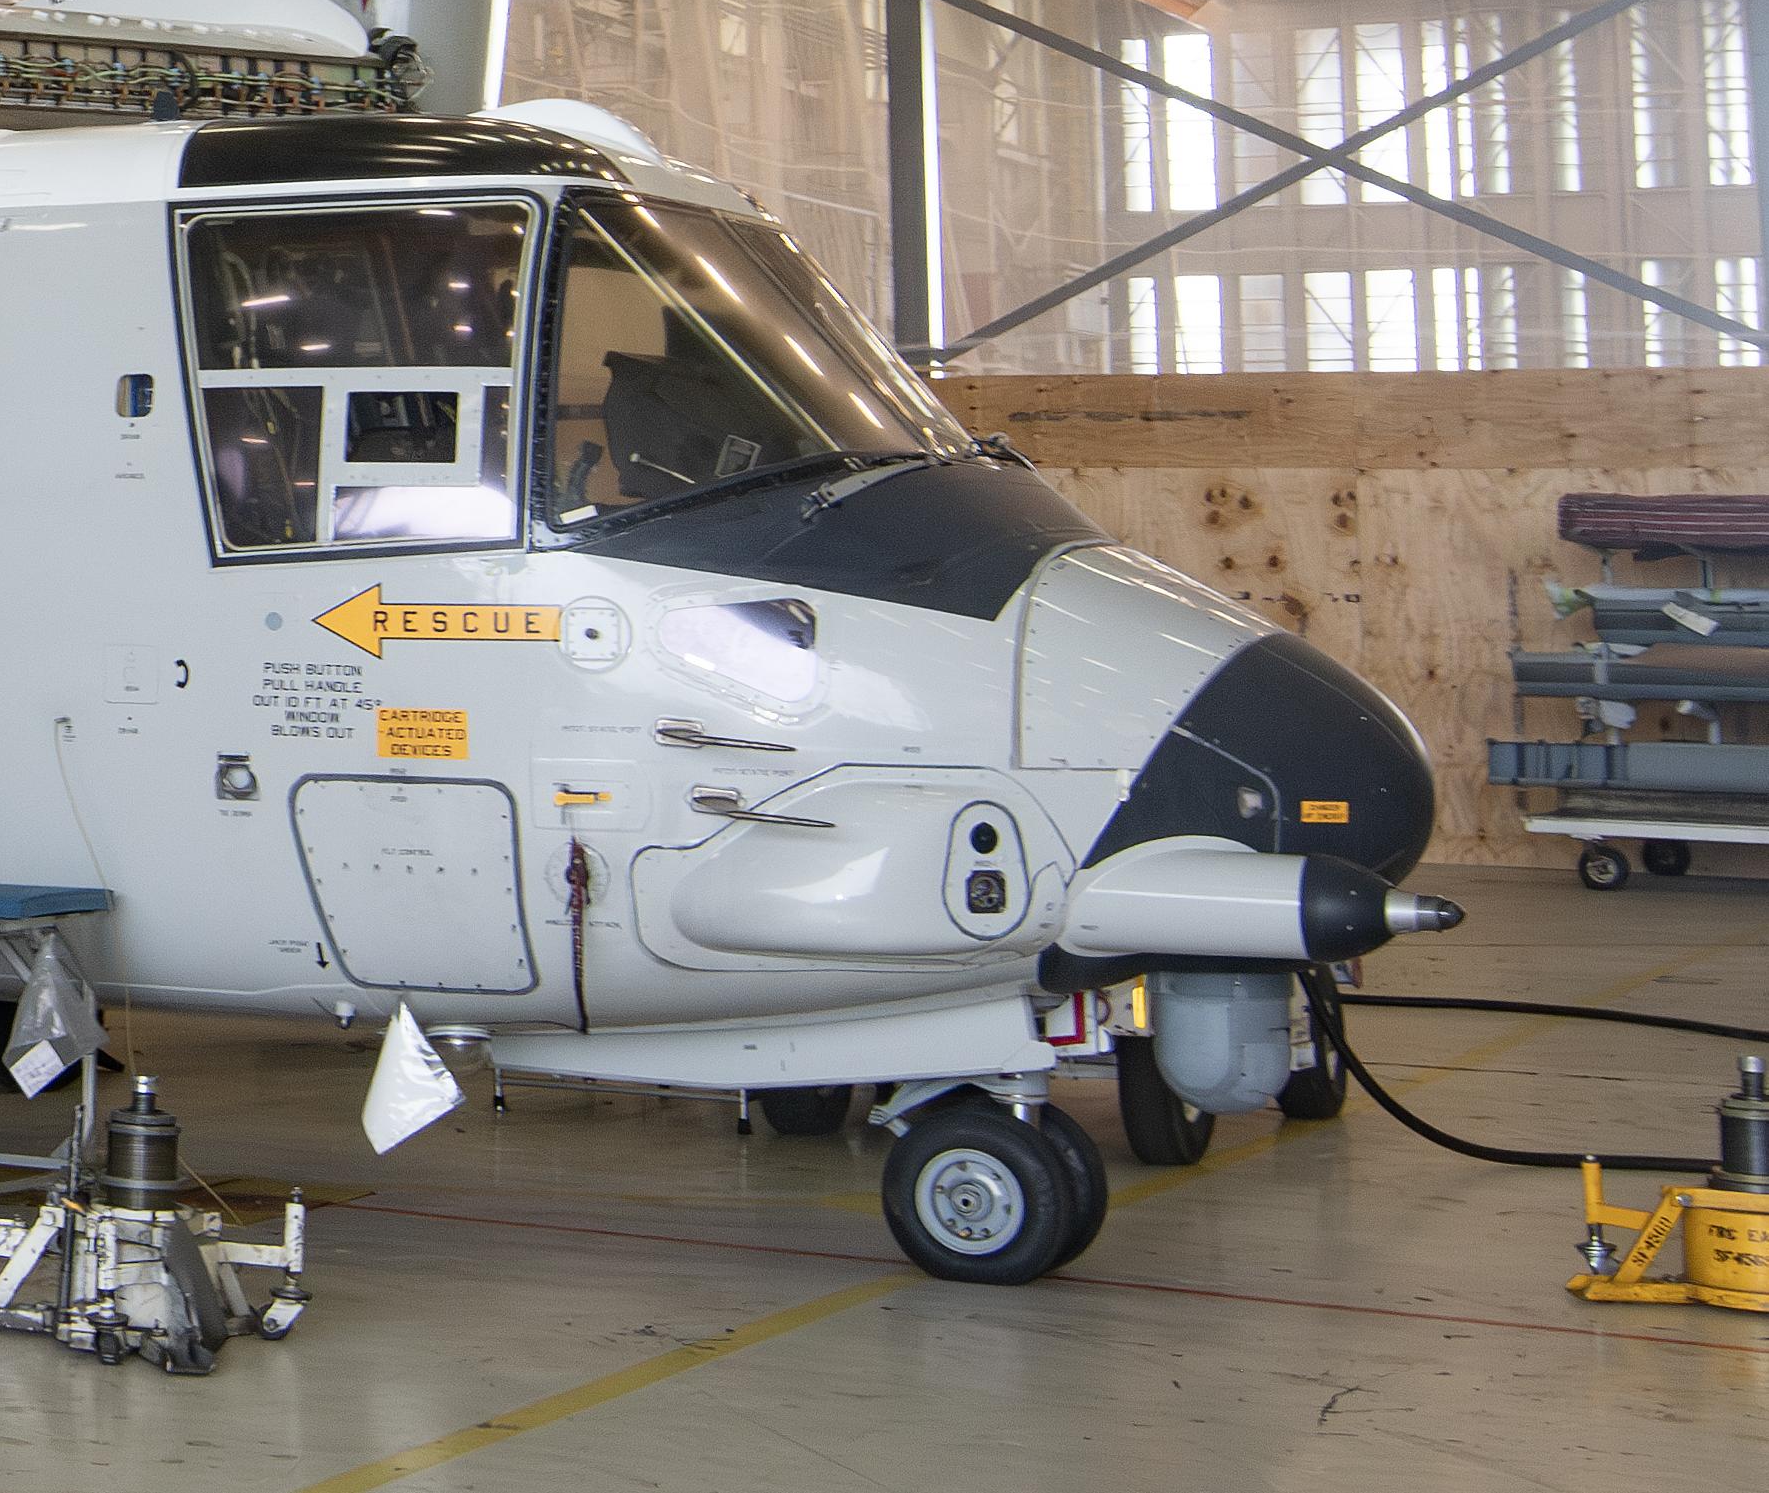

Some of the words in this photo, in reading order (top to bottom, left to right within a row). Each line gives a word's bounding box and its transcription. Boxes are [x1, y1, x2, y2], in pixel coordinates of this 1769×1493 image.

[372, 609, 543, 634] RESCUE
[262, 661, 301, 676] PUSH
[305, 663, 363, 677] BUTTON
[262, 678, 299, 692] PULL
[304, 679, 363, 694] HANDLE
[252, 694, 282, 708] OUT
[285, 695, 300, 708] 10
[303, 696, 322, 708] FT
[328, 697, 348, 710] AT
[283, 709, 341, 723] WINDOW
[378, 709, 464, 724] CARTRIDGE
[270, 724, 321, 738] BLOWS
[325, 726, 355, 739] OUT
[389, 743, 454, 757] DEVICES
